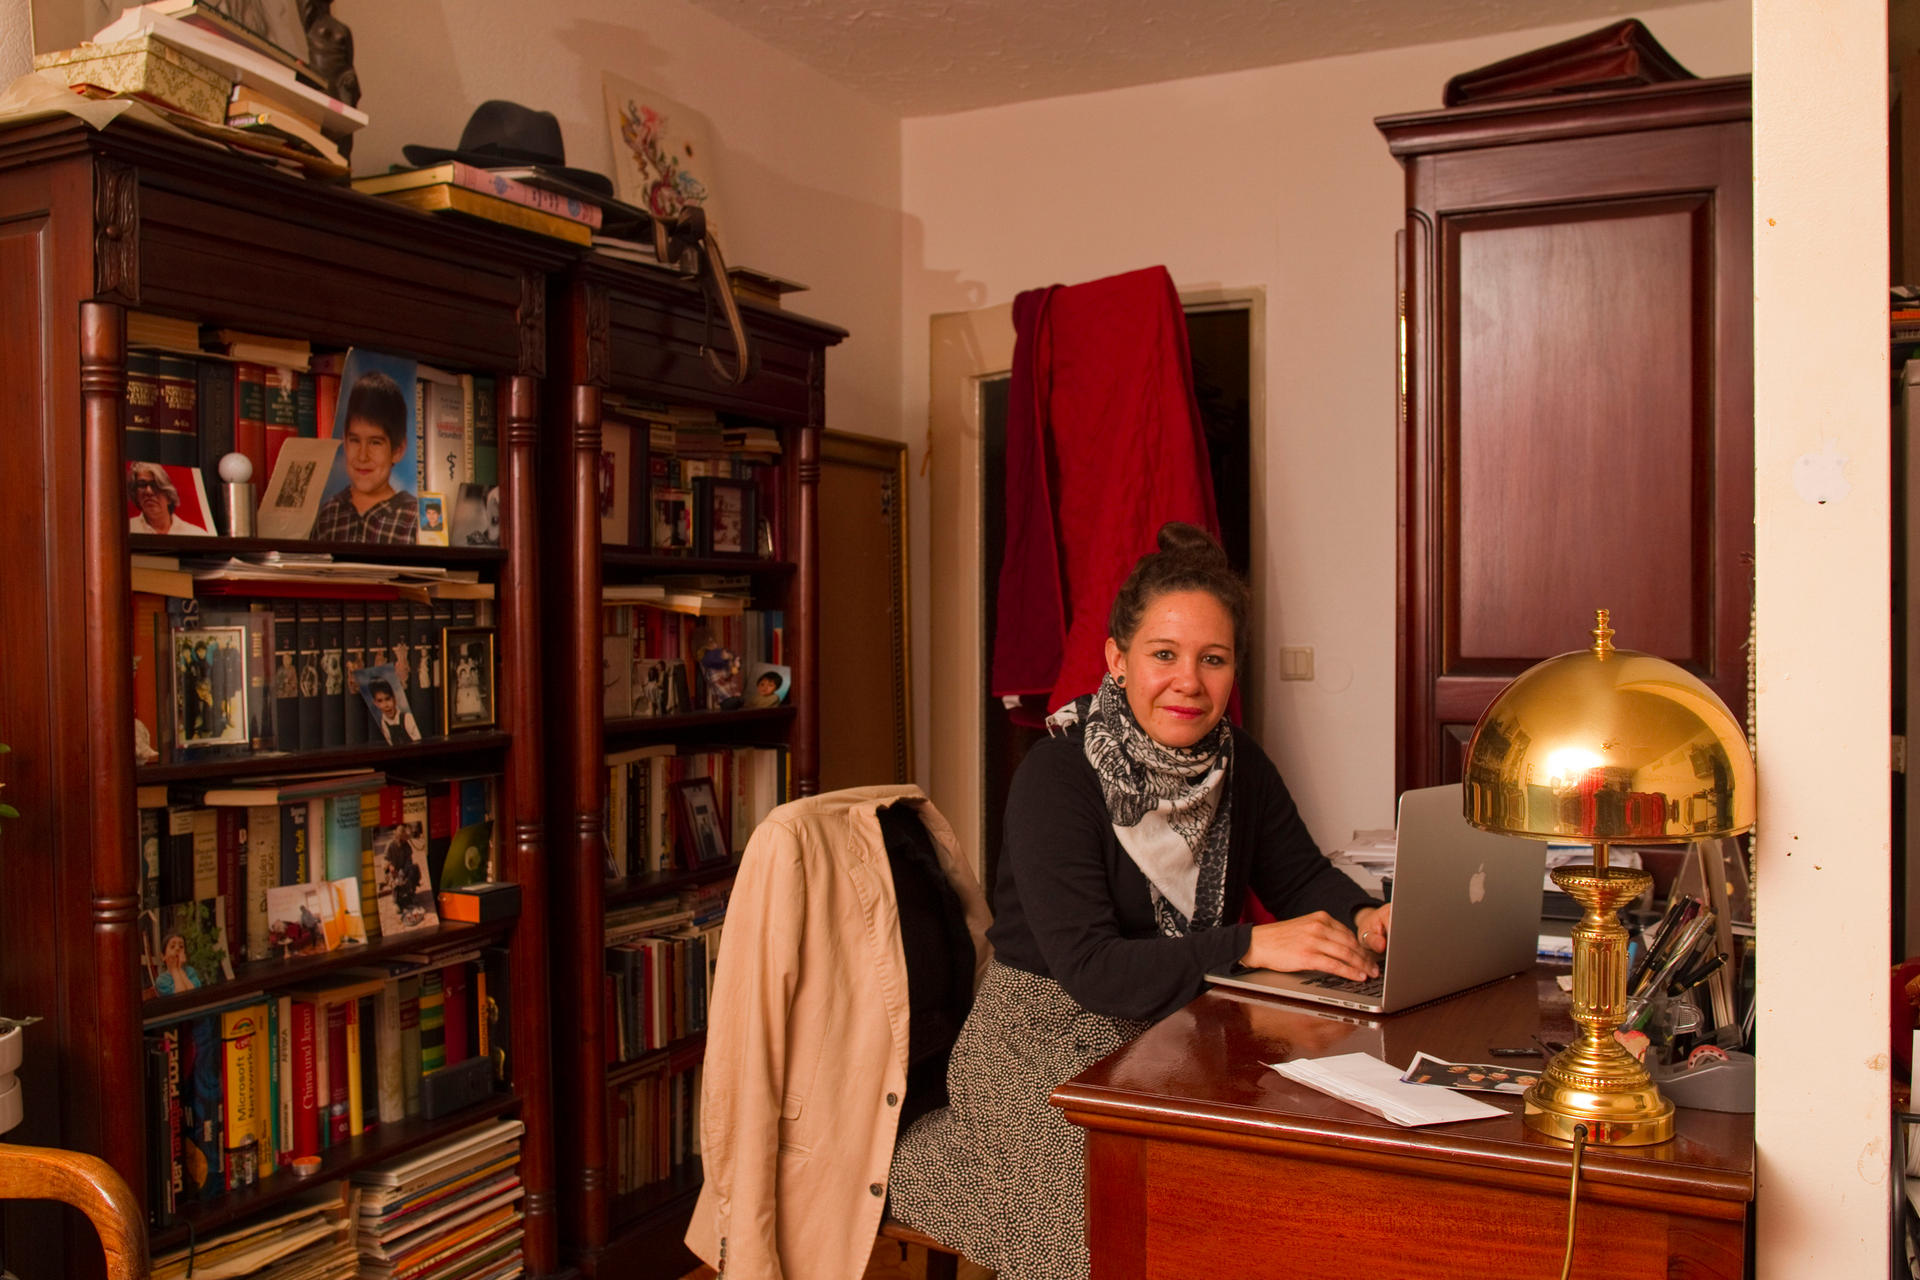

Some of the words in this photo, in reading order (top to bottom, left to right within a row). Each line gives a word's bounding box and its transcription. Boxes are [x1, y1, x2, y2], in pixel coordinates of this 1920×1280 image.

[300, 1008, 313, 1042] Japan
[300, 1045, 313, 1069] und
[237, 1056, 247, 1122] Microsoft
[302, 1071, 313, 1110] China
